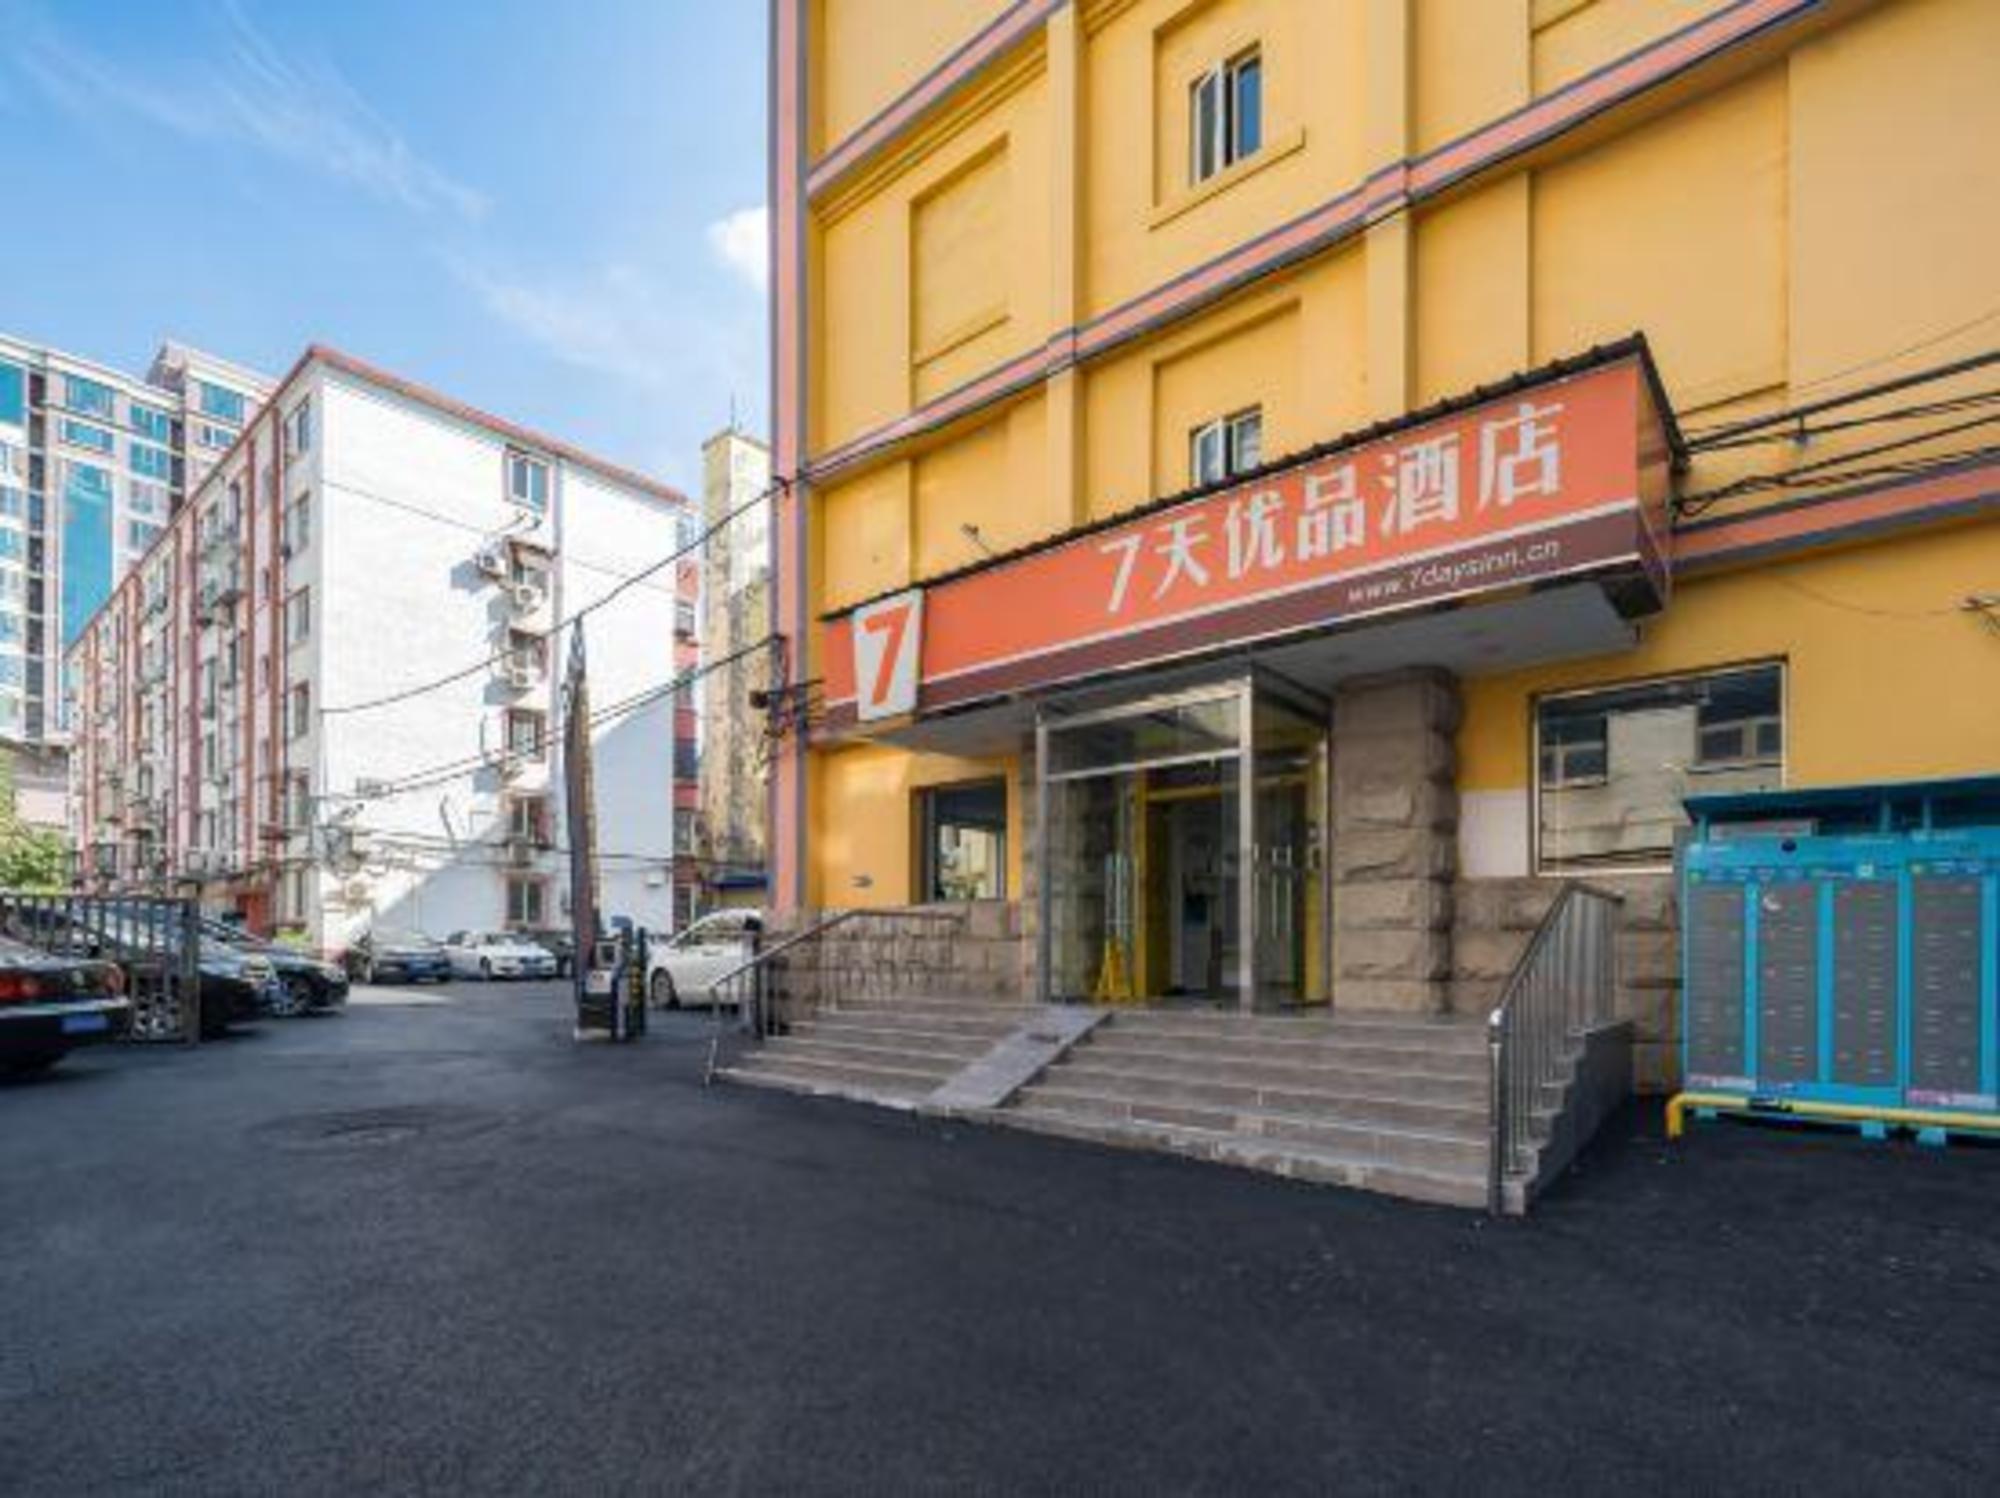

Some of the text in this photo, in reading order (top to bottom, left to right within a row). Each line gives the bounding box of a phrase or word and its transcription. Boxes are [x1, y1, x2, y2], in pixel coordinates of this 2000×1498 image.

[1101, 403, 1563, 613] 7天优品酒店
[1347, 539, 1560, 604] www.7daysinn.cn
[864, 605, 911, 706] 7
